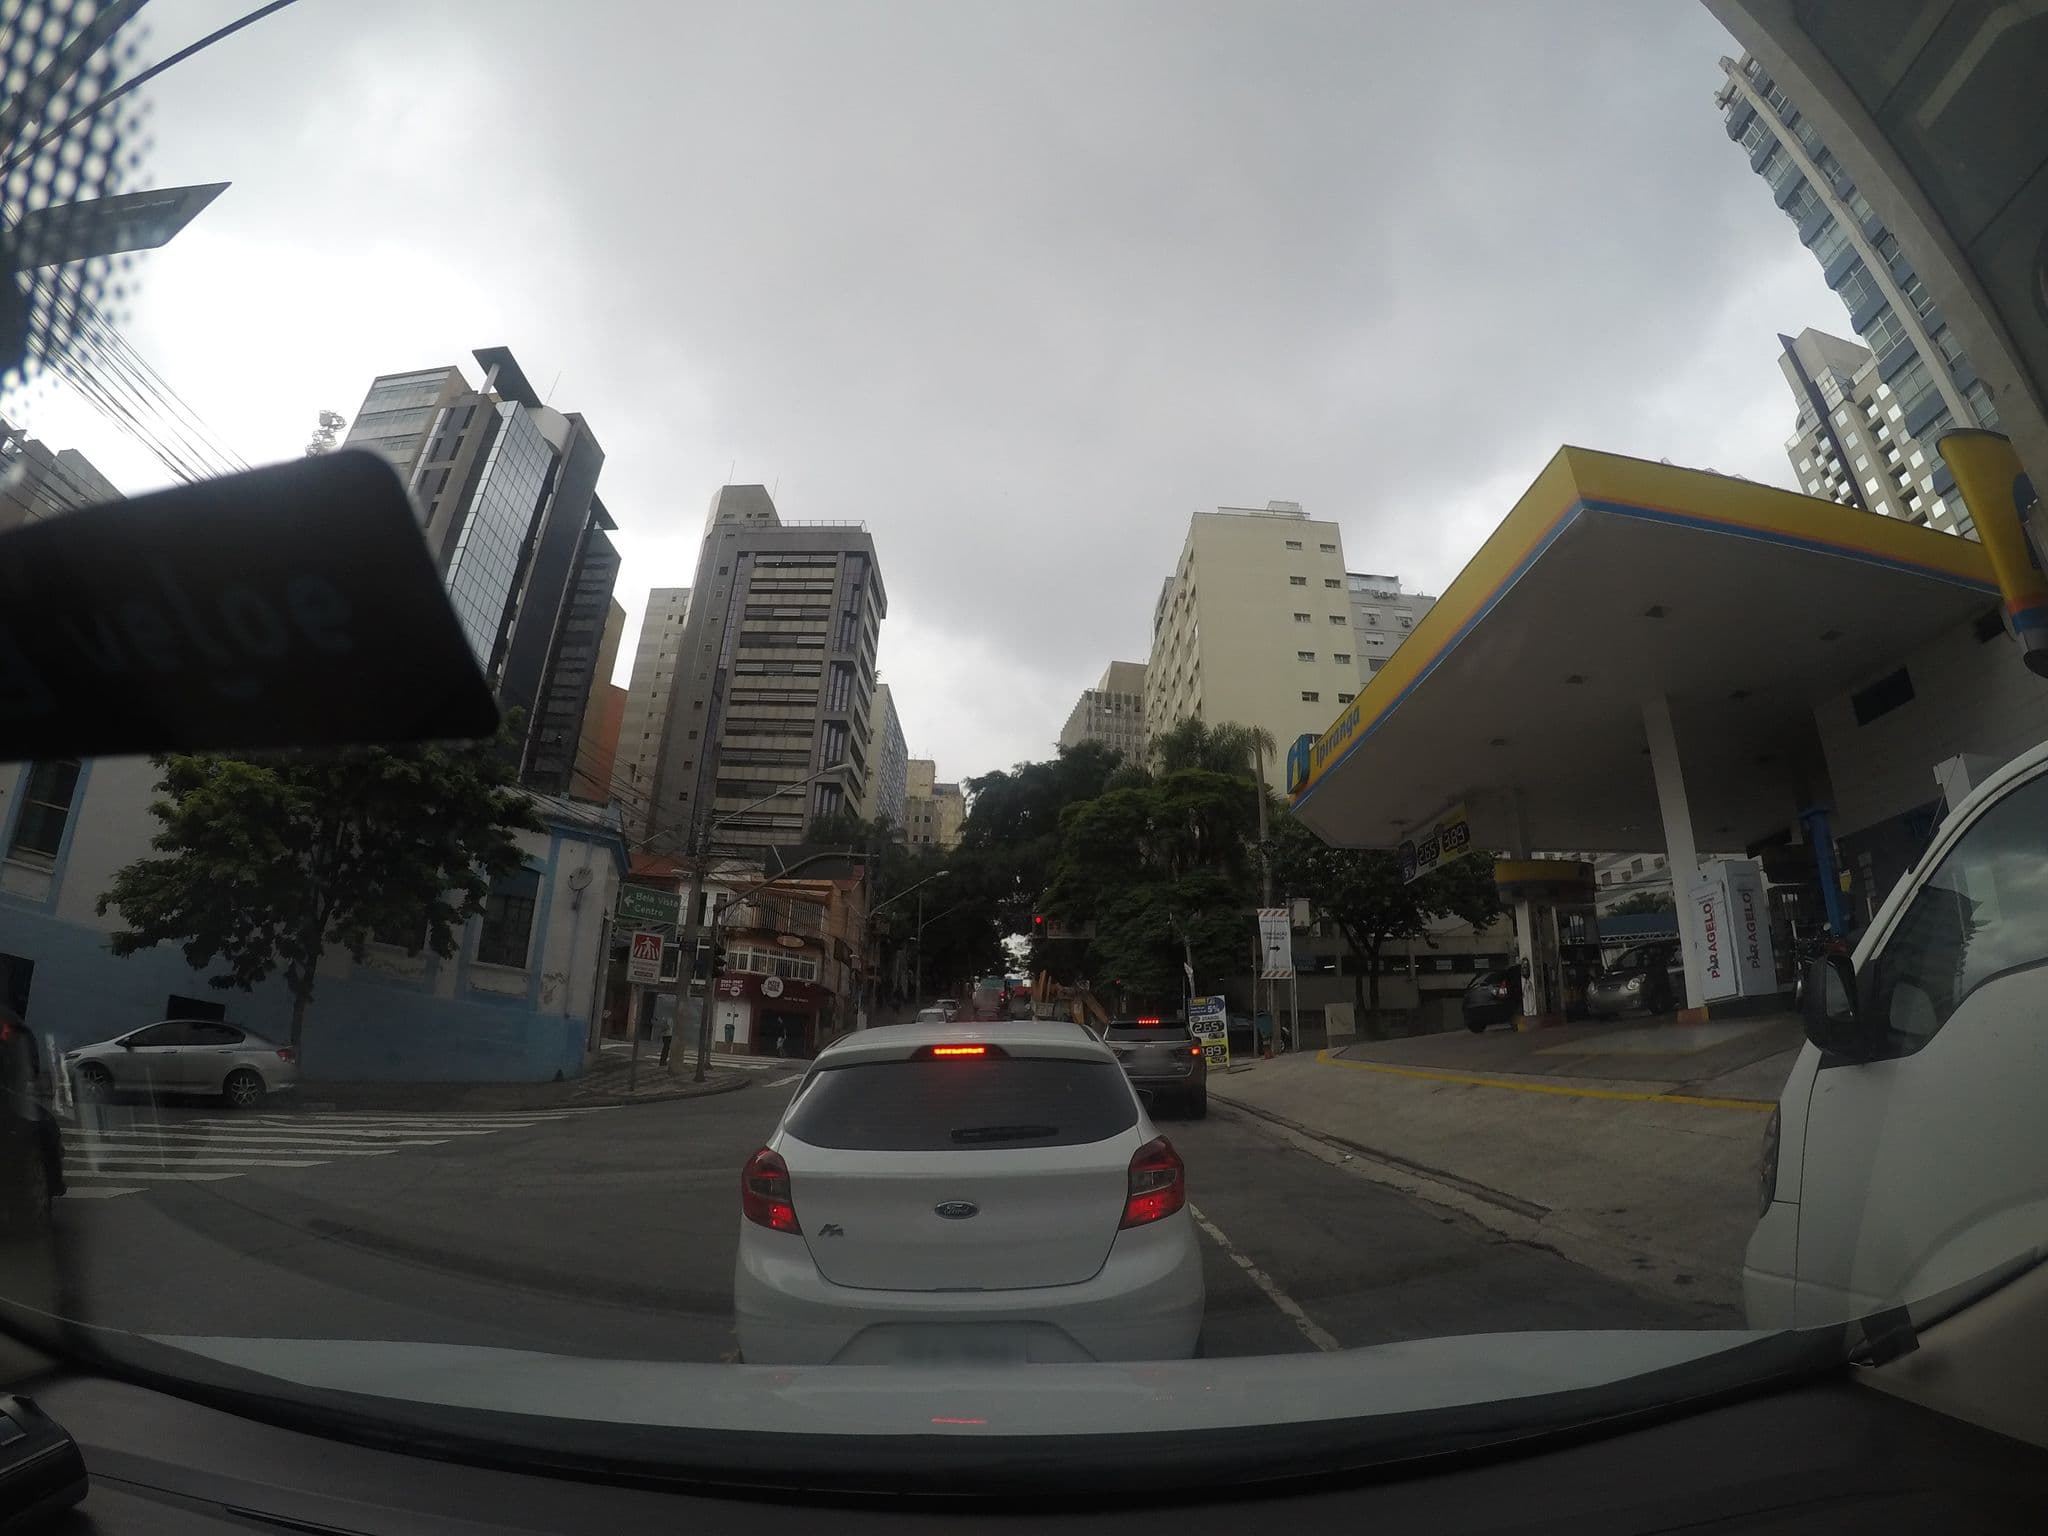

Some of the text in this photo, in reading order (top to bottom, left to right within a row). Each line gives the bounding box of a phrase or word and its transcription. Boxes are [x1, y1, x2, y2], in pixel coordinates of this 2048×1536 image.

[1317, 706, 1360, 768] Ipiranga
[635, 891, 679, 908] Bela Vista
[634, 904, 664, 917] Centro
